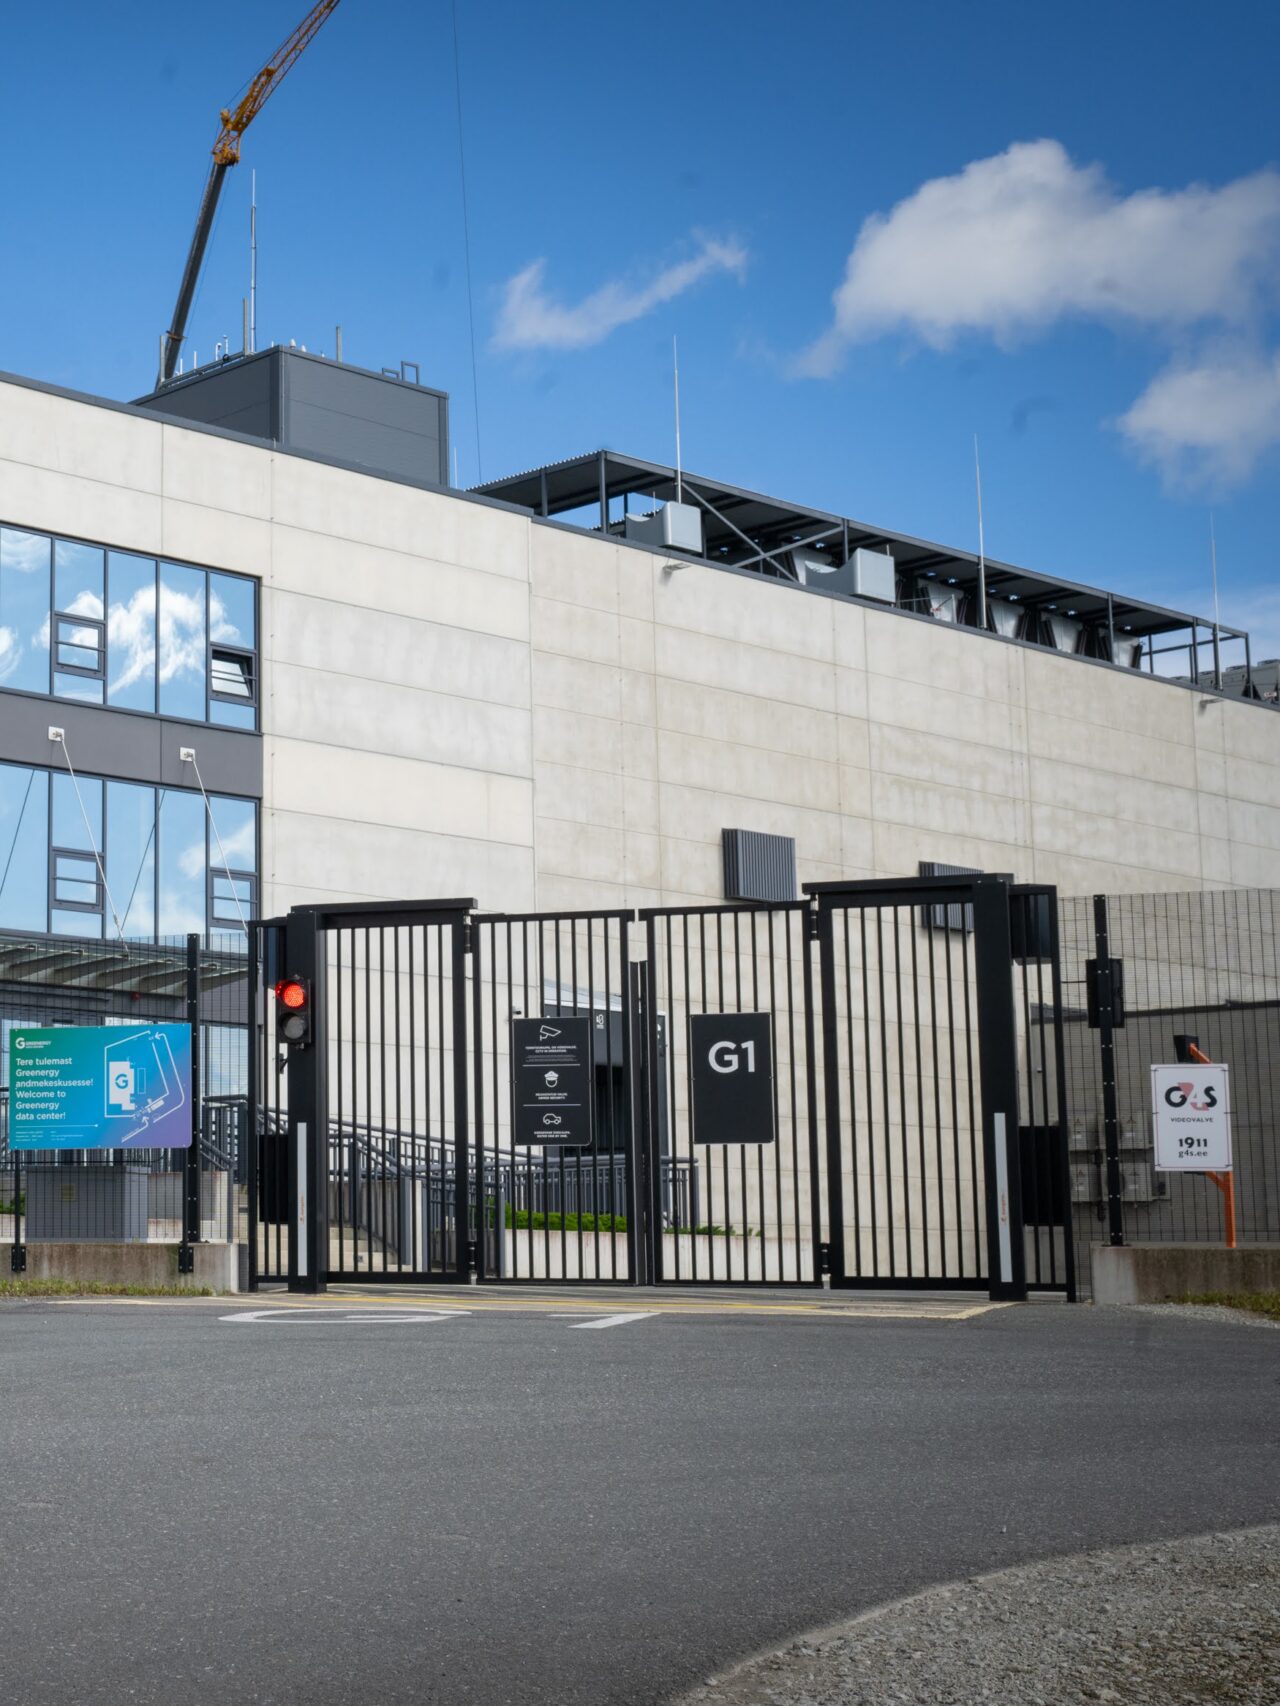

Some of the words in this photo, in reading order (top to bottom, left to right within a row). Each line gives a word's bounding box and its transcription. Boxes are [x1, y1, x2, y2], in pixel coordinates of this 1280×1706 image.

[708, 1040, 756, 1073] G1
[15, 1057, 33, 1066] Tere
[35, 1057, 72, 1066] tulemast
[15, 1069, 60, 1077] Greenergy
[15, 1078, 94, 1088] andmekeskusesse!
[15, 1090, 55, 1098] Welcome
[57, 1090, 66, 1098] to
[1164, 1082, 1218, 1111] G4S
[15, 1101, 60, 1110] Greenergy
[15, 1112, 34, 1120] data
[36, 1112, 66, 1120] center!
[1178, 1137, 1207, 1148] 1911
[1178, 1150, 1208, 1158] g4s.ee
